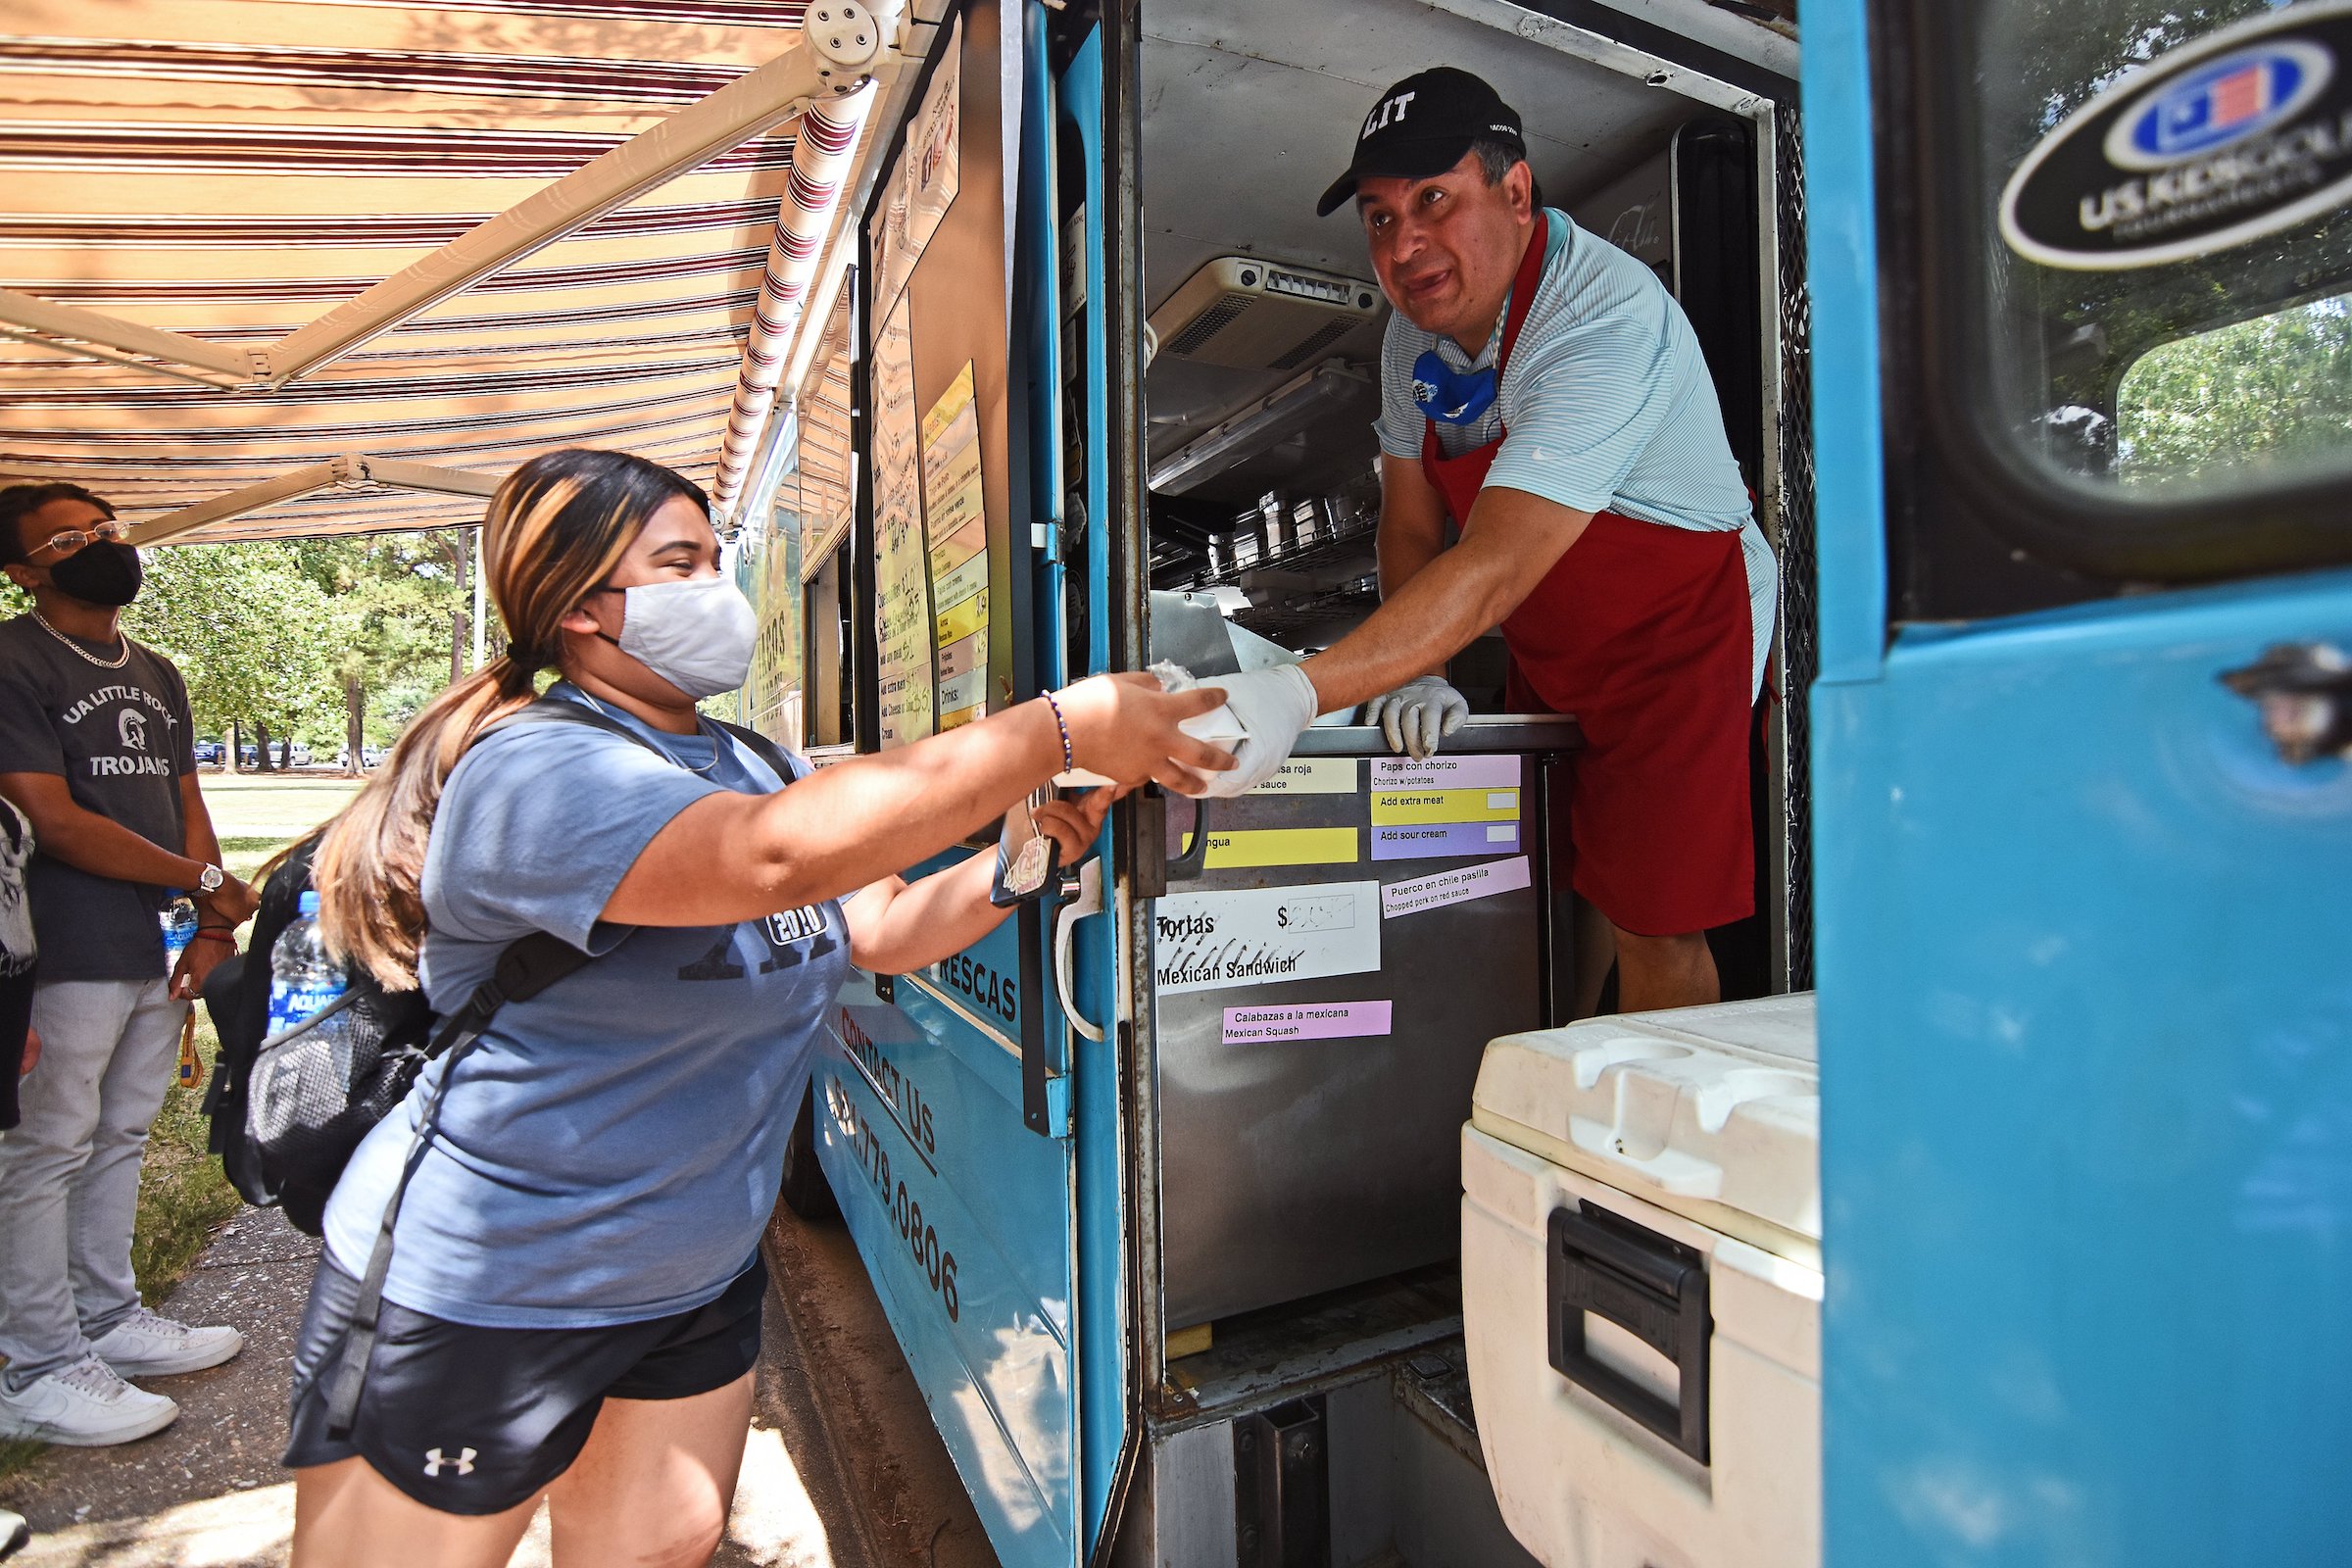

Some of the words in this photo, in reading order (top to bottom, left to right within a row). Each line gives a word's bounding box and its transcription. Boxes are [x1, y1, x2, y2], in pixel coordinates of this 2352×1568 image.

[1362, 91, 1416, 140] LIT
[63, 699, 95, 724] UA
[89, 686, 141, 707] LITTLE
[142, 690, 178, 730] ROCK
[90, 755, 171, 777] TROJANS
[1294, 764, 1312, 776] roja
[1380, 761, 1403, 773] Paps
[1405, 762, 1422, 771] con
[1425, 760, 1458, 771] chorizo
[1373, 777, 1398, 786] Chorizo
[1399, 776, 1435, 787] w/potatoes
[1380, 797, 1397, 807] Add
[1399, 796, 1421, 806] extra
[1423, 796, 1445, 806] meat
[1205, 838, 1231, 850] ngua
[1380, 831, 1398, 841] Add
[1399, 832, 1420, 841] sour
[1421, 830, 1447, 839] cream
[1391, 884, 1423, 898] Puerco
[1425, 881, 1437, 891] en
[1438, 873, 1460, 888] chile
[1385, 899, 1414, 913] Chopped
[1414, 895, 1430, 906] pork
[1430, 894, 1439, 903] on
[1440, 891, 1450, 901] red
[1450, 888, 1470, 899] sauce
[1156, 913, 1215, 938] Tortas
[1157, 965, 1221, 987] Mexican
[1226, 956, 1297, 979] Sandwich
[927, 954, 1016, 1022] RESCAS
[287, 993, 343, 1012] AQUAF
[1235, 1009, 1285, 1023] Calabazas
[1295, 1010, 1304, 1020] la
[1306, 1007, 1349, 1019] mexicana
[1225, 1027, 1263, 1039] Mexican
[1265, 1025, 1300, 1038] Squash
[841, 1005, 902, 1111] CONTACT
[906, 1077, 935, 1154] US
